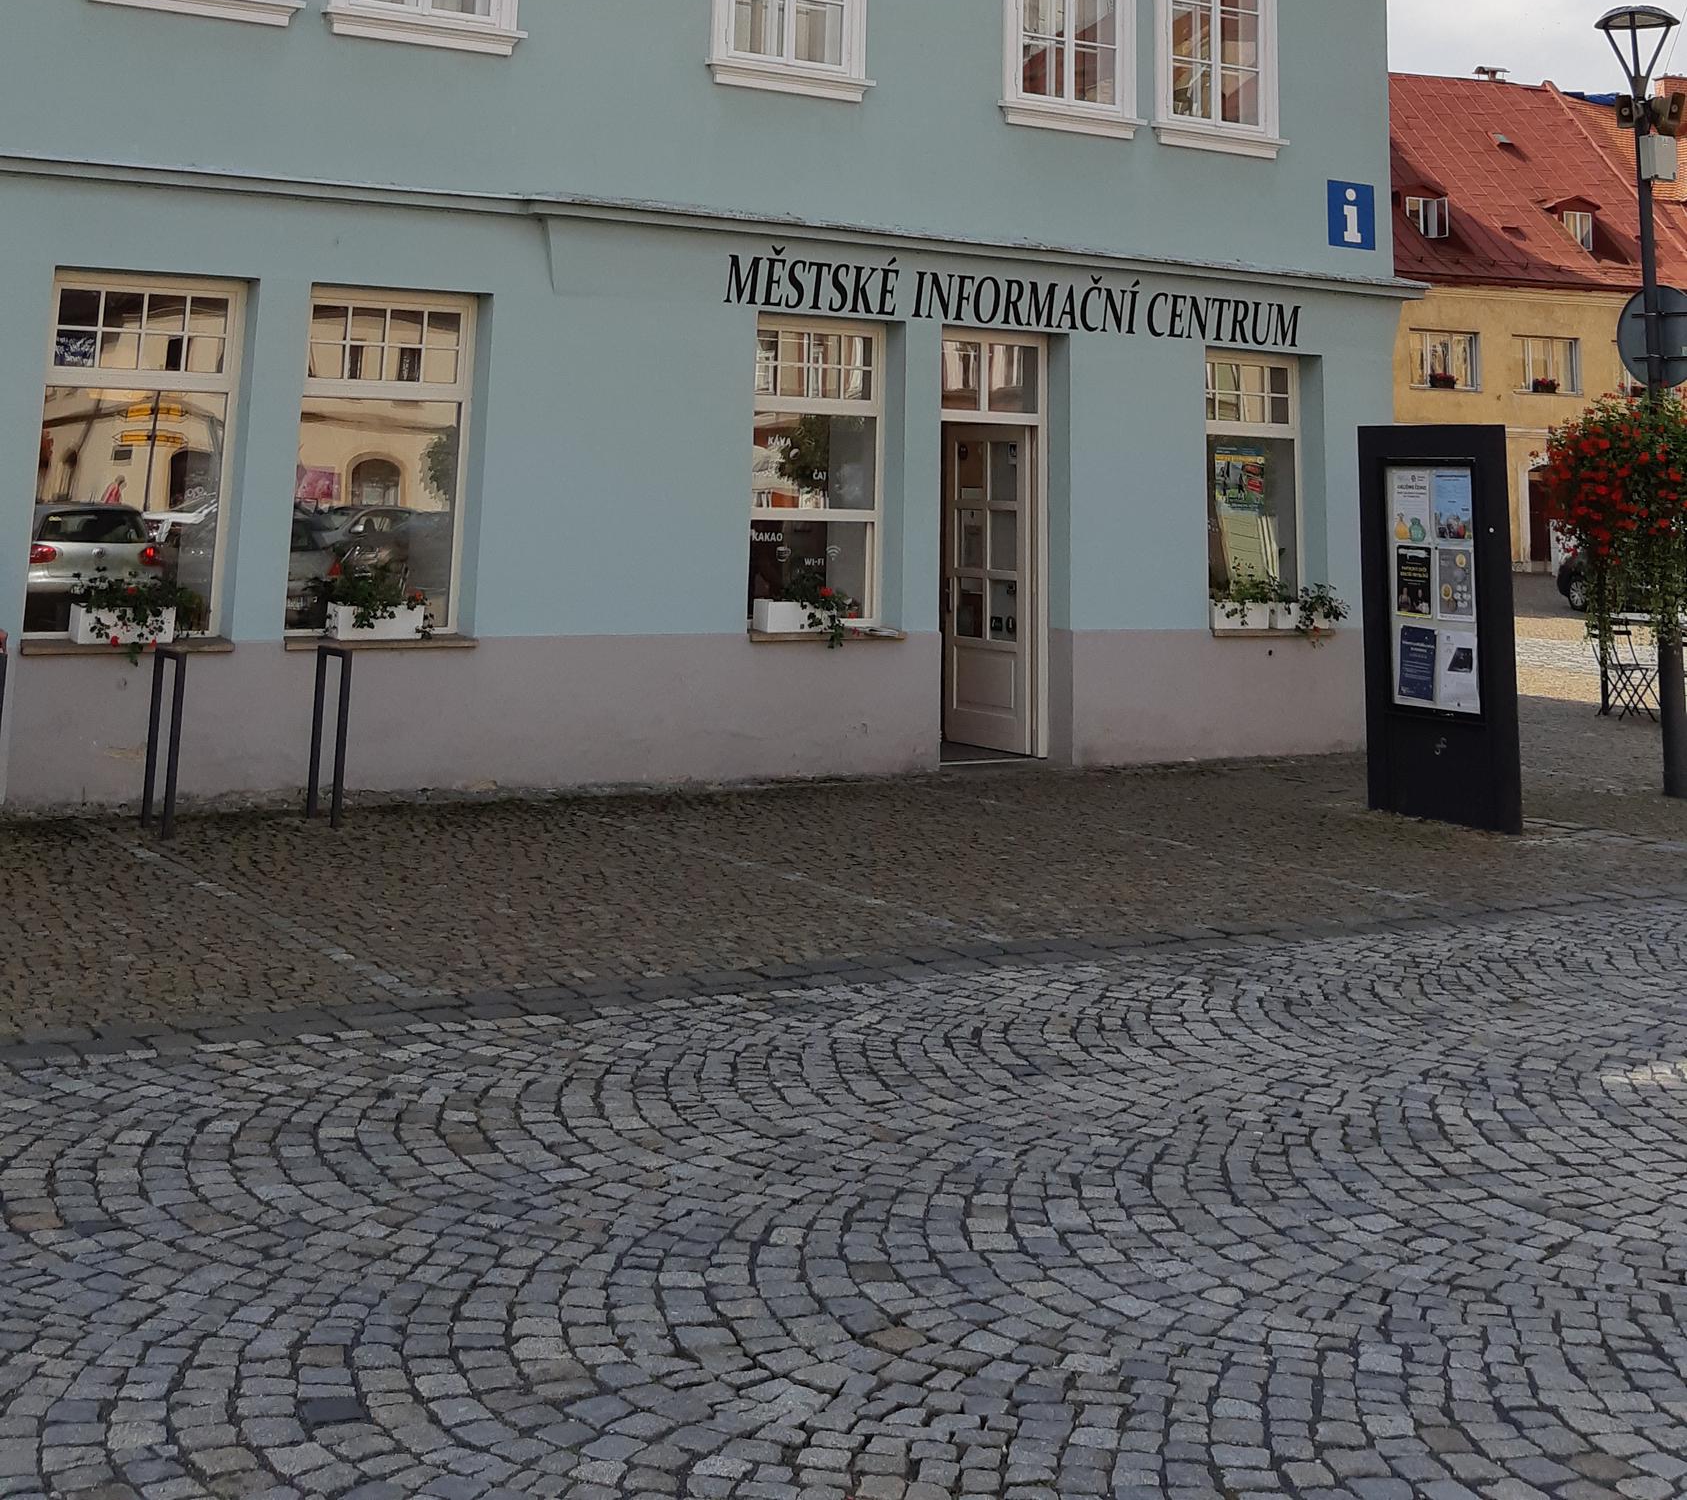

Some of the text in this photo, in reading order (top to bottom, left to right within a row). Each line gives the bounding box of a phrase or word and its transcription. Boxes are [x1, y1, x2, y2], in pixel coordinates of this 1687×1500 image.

[725, 245, 1301, 348] MĚSTSKÉ INFORMAČNÍ CENTRUM
[767, 435, 792, 447] KÁVA
[812, 469, 827, 481] ČAJ
[751, 531, 783, 542] KAKAO
[804, 557, 825, 566] WI-FI
